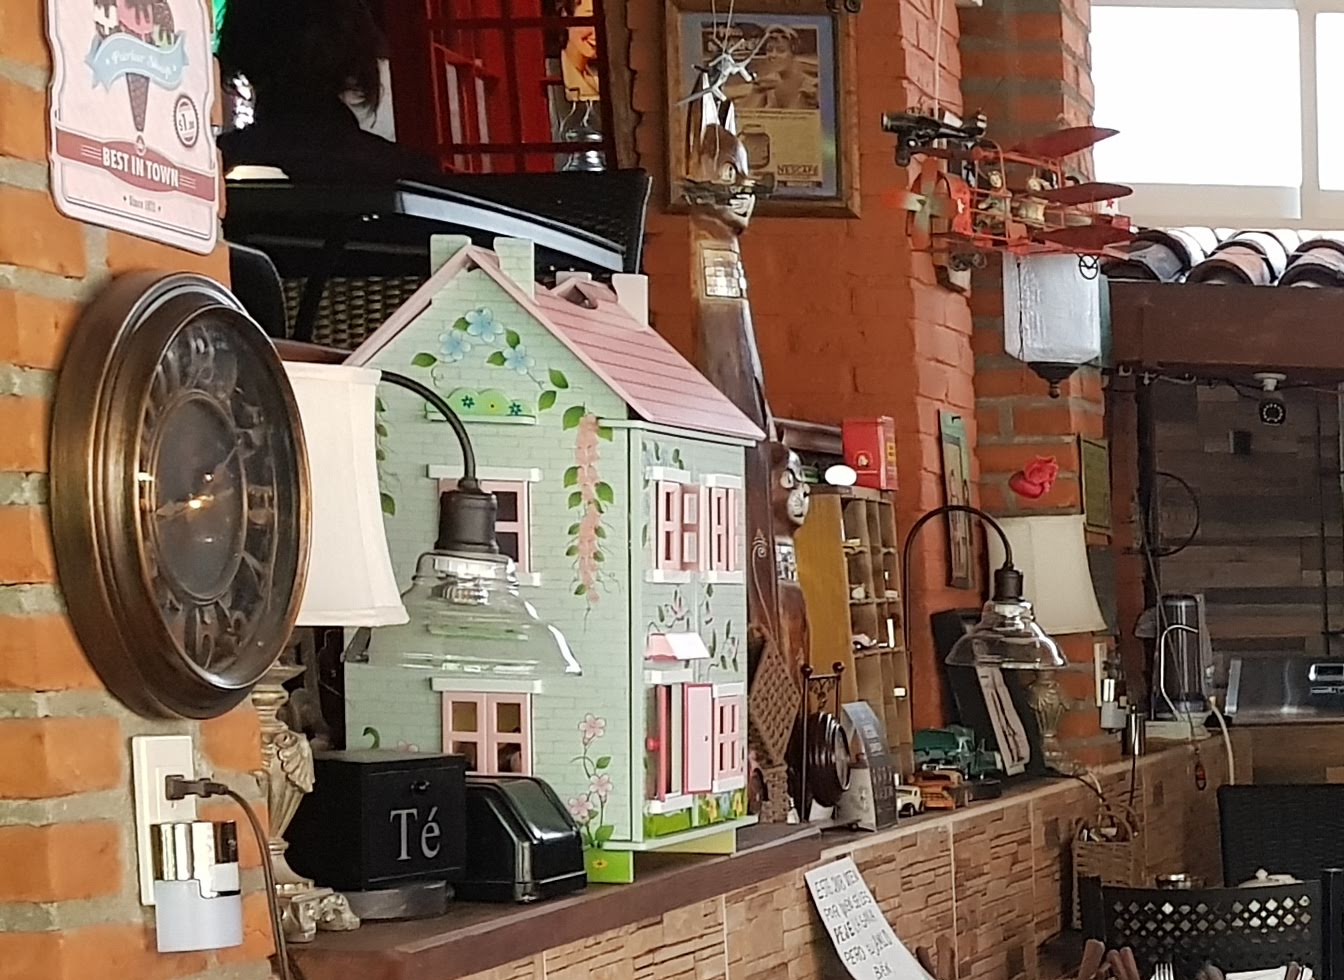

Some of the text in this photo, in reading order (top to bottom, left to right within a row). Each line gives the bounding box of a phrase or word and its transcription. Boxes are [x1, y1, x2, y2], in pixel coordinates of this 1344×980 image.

[102, 147, 179, 187] BEST IN TOWN
[389, 806, 441, 861] Té
